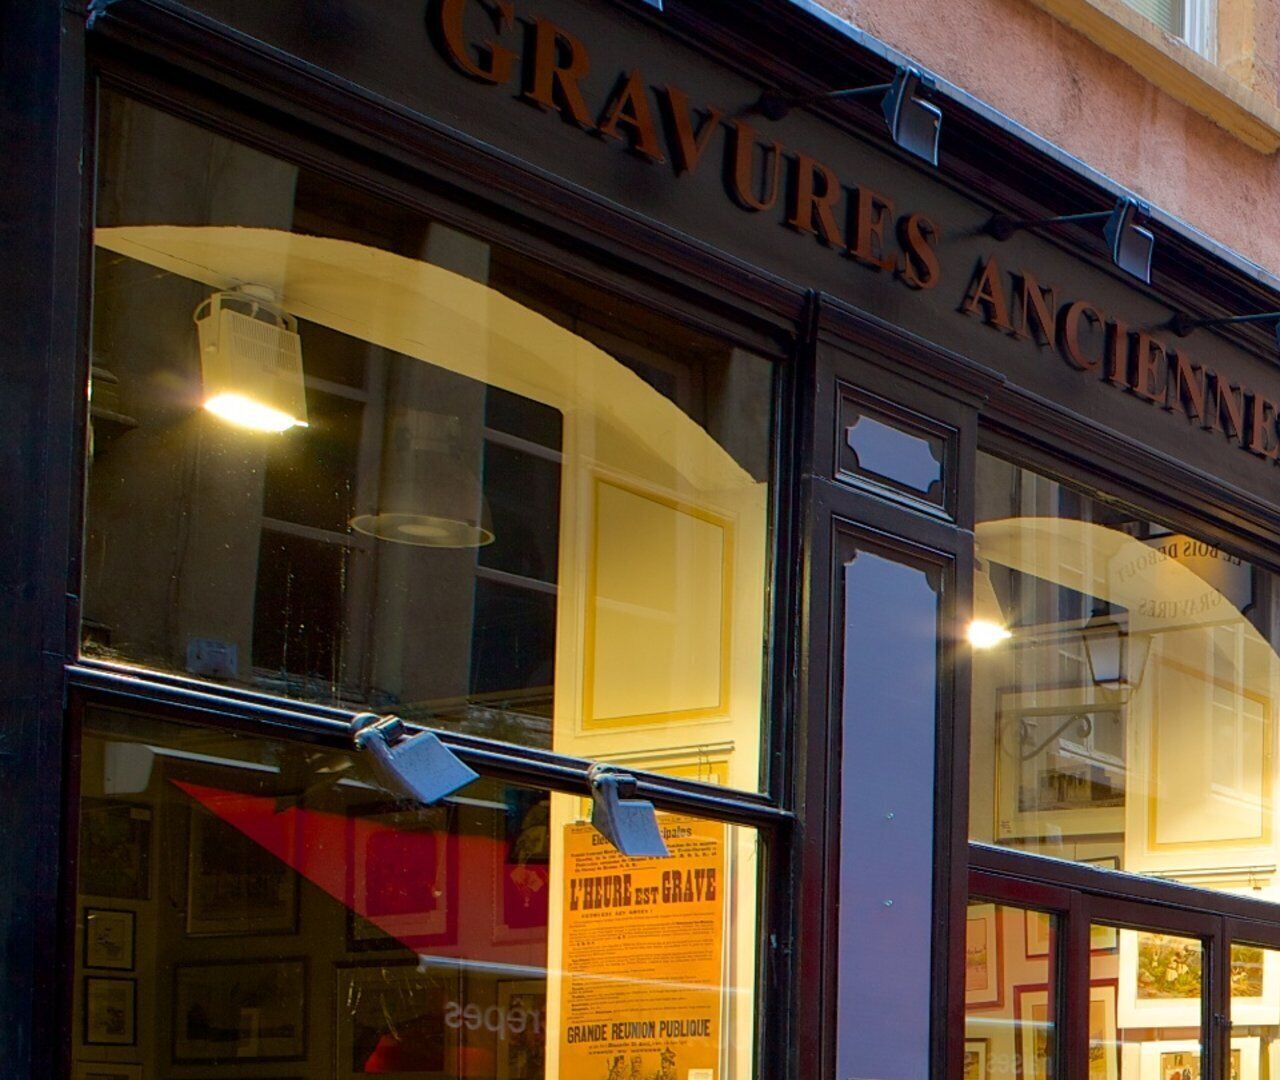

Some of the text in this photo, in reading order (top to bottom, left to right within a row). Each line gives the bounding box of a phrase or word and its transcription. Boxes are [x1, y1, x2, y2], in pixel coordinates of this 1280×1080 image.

[438, 0, 942, 290] GRAVURES
[570, 868, 716, 911] L'HEURE EST GRAVE
[567, 1024, 608, 1044] GRANDE
[658, 1019, 712, 1038] PUBLIQUE
